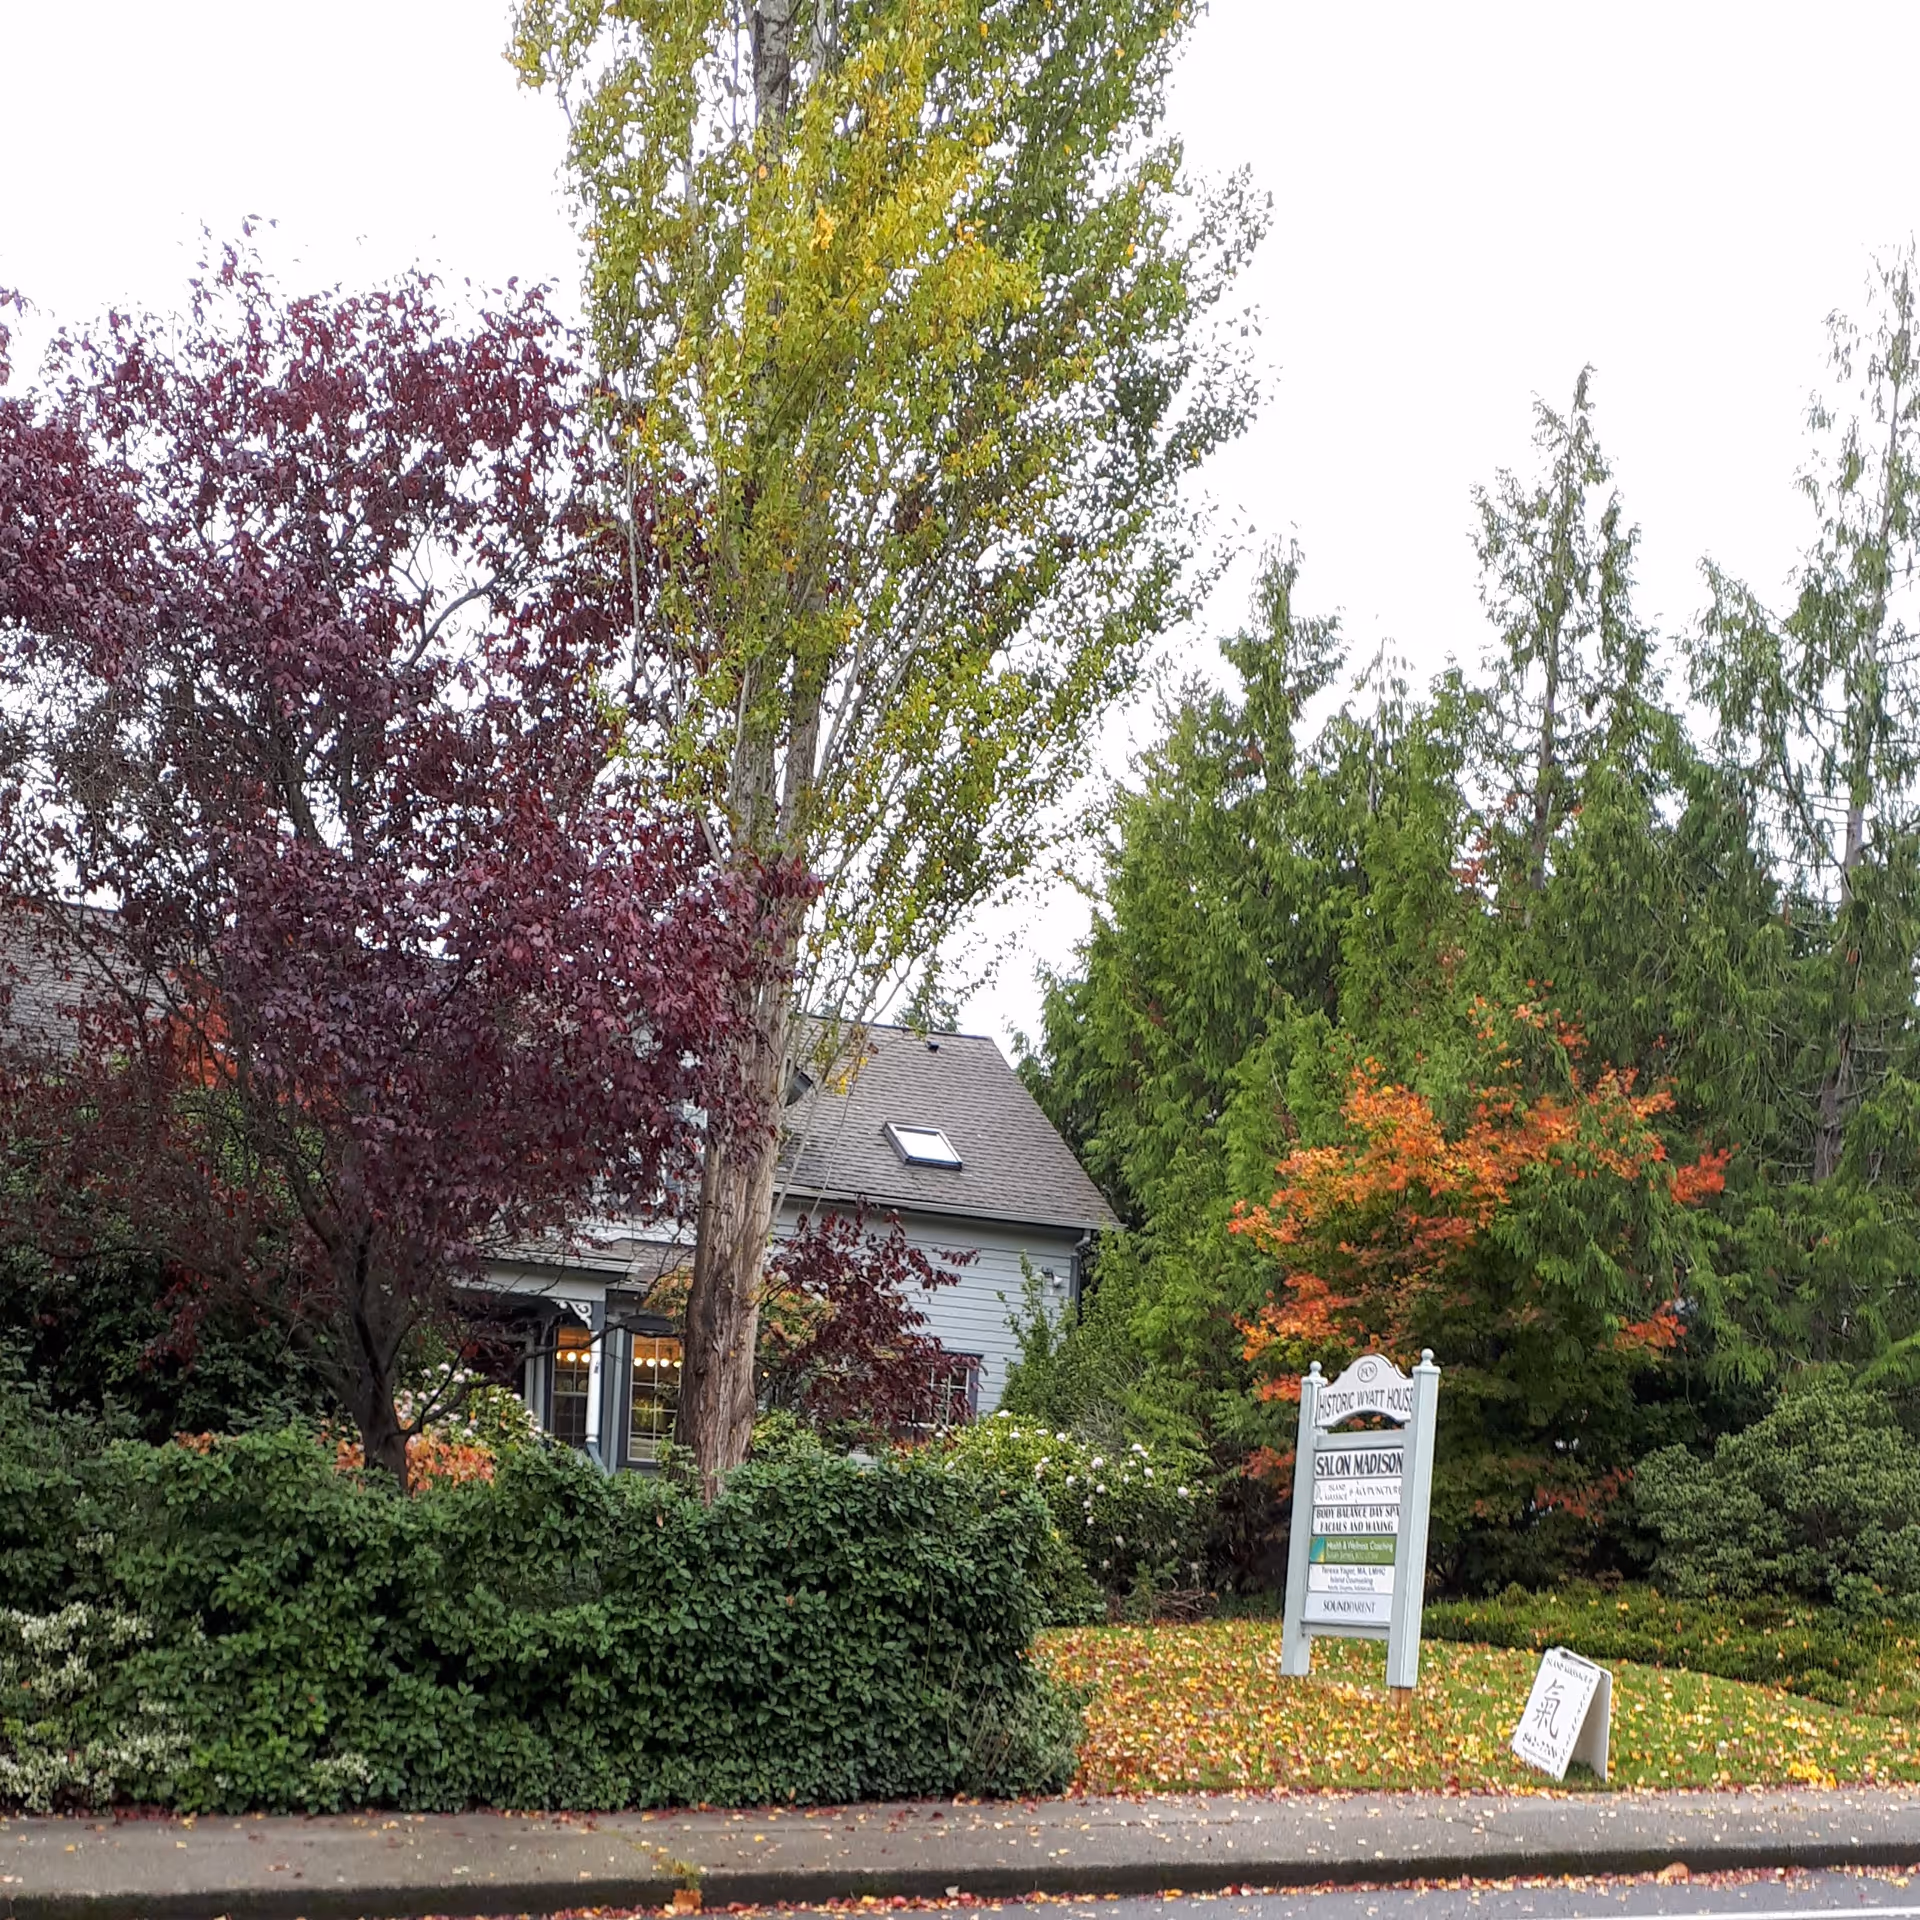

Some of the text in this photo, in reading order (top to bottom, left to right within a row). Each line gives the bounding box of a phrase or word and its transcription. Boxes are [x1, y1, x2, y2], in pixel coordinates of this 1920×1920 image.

[1319, 1391, 1354, 1420] HISTORIC
[1357, 1389, 1385, 1407] WYATT
[1316, 1452, 1403, 1476] SALON MADISON
[1316, 1505, 1400, 1519] BODY BALANCE DAY SPA
[1320, 1520, 1393, 1532] FACIALS AND WAXING
[1369, 1540, 1393, 1553] Coaching
[1532, 1678, 1565, 1740] 氣
